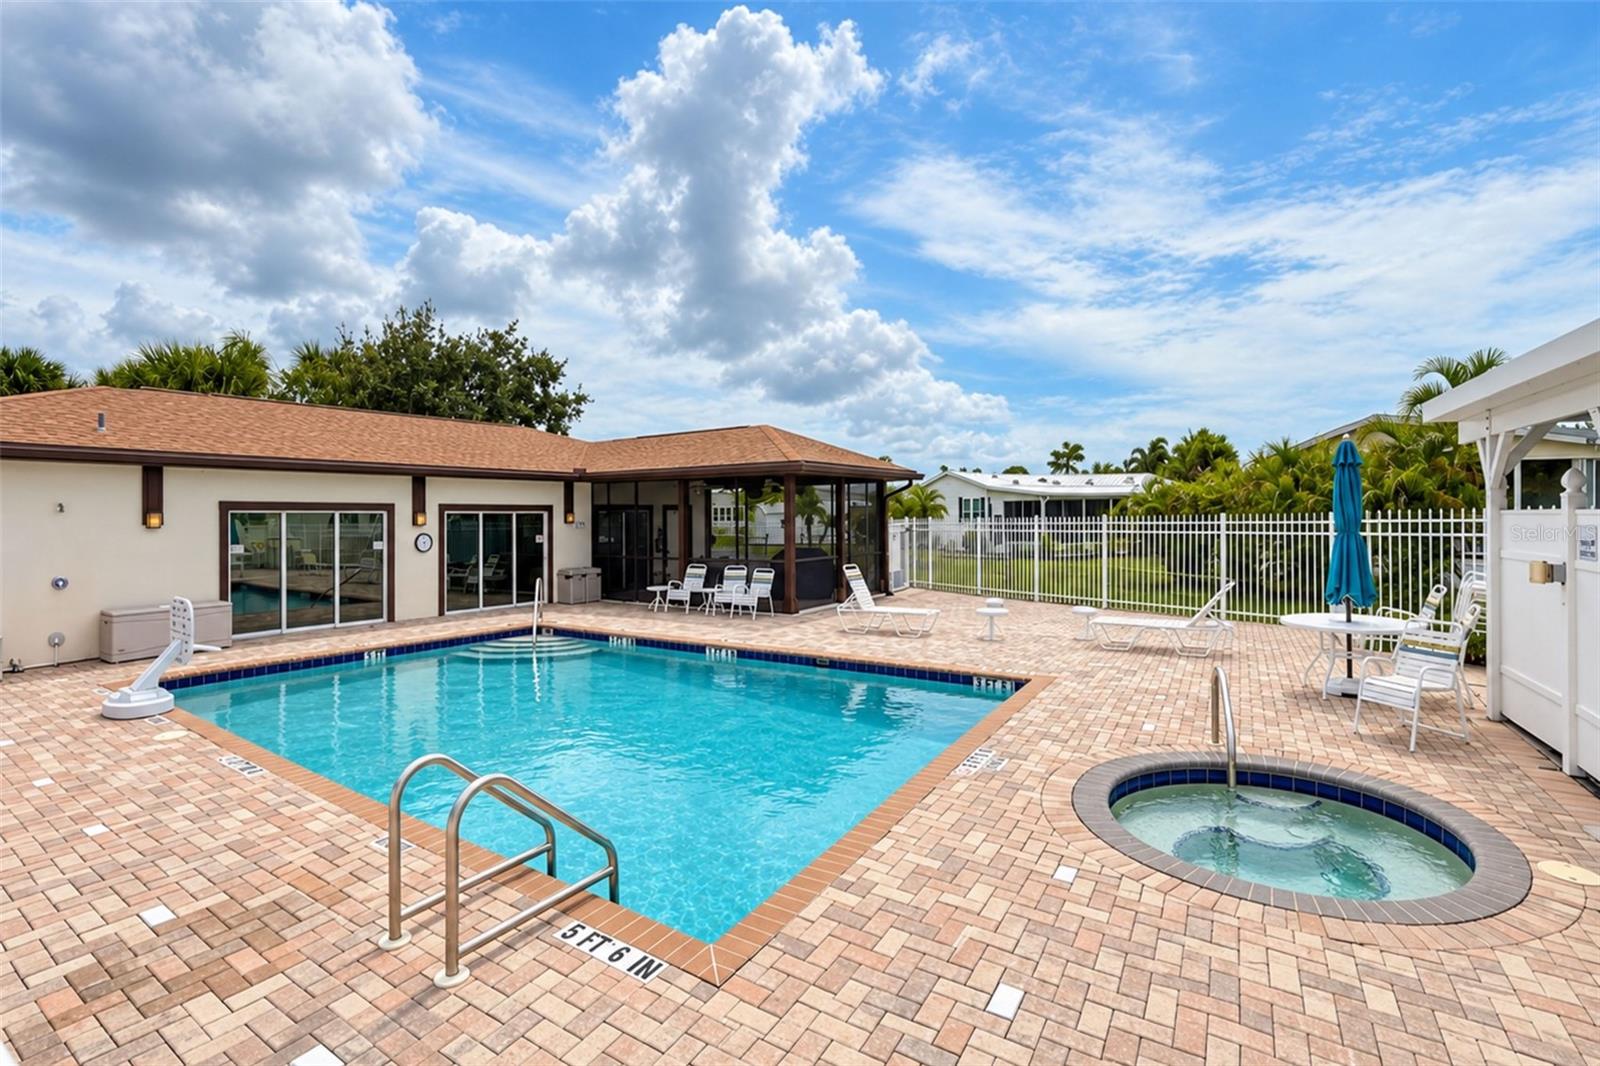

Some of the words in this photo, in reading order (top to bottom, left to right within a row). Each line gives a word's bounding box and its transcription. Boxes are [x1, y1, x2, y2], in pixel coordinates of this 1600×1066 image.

[561, 924, 586, 939] 5
[608, 947, 631, 962] 6
[627, 955, 663, 980] IN
